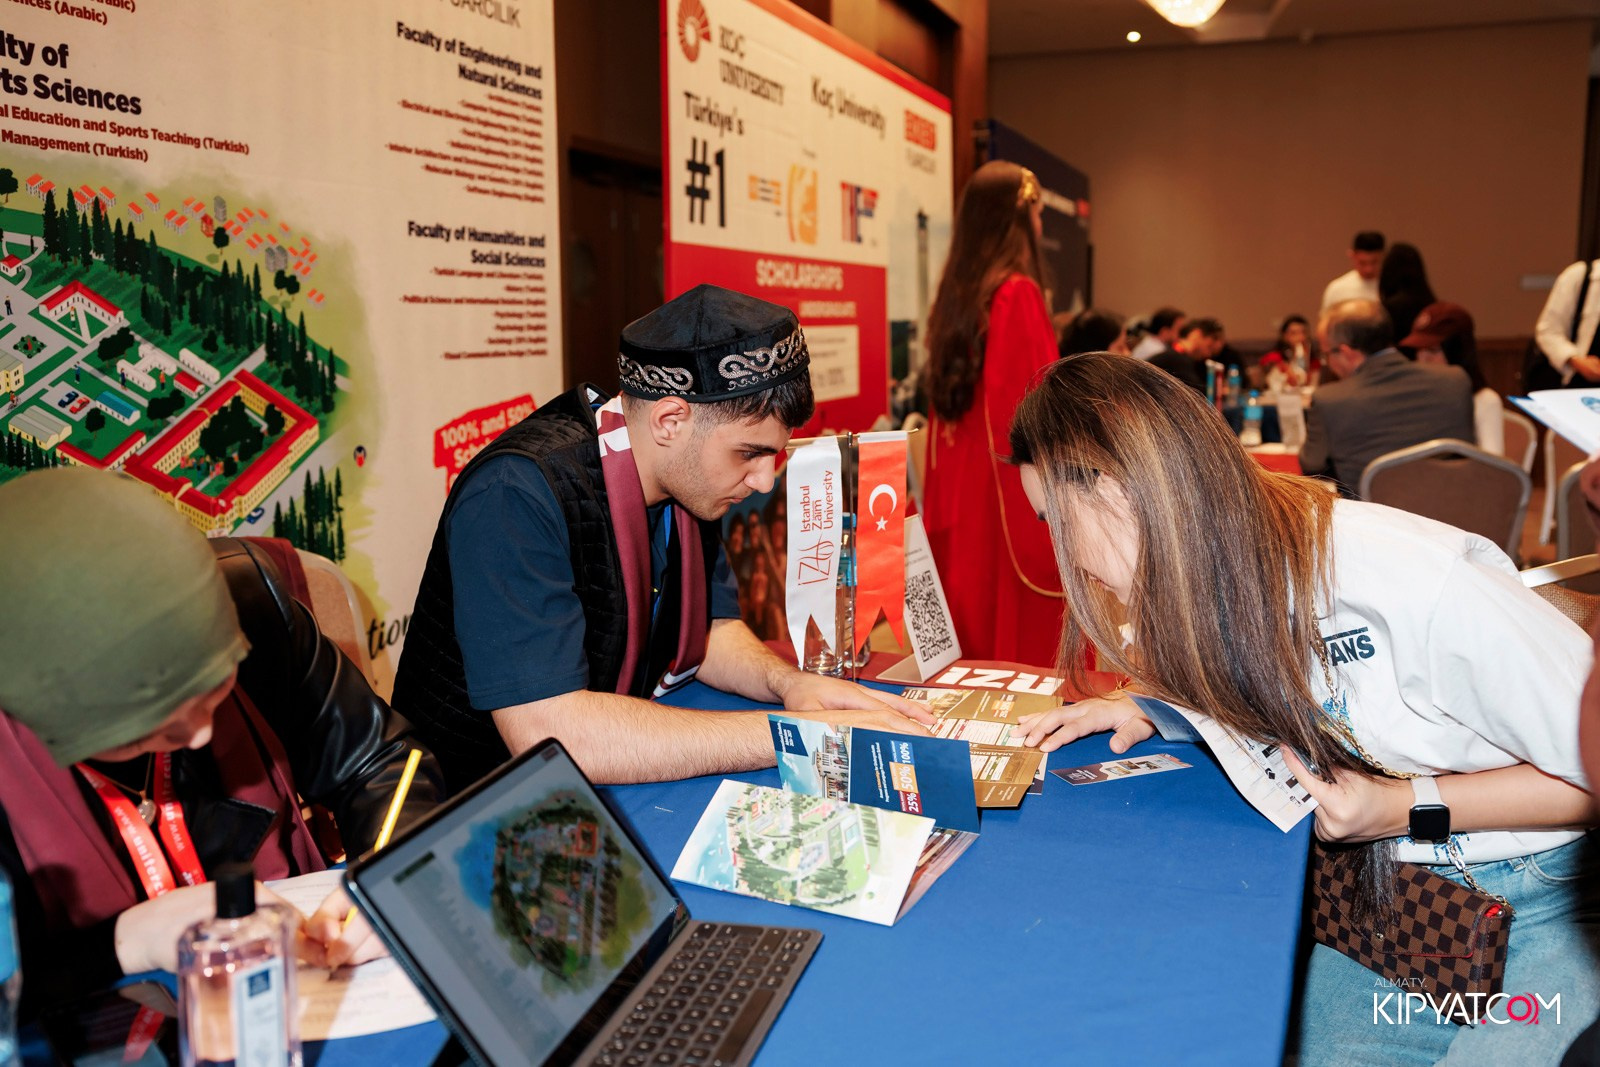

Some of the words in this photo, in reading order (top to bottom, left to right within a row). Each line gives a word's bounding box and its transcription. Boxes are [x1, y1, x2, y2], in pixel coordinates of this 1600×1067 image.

[54, 2, 108, 26] (Arabic)
[42, 43, 69, 69] of
[396, 21, 442, 52] Faculty
[445, 38, 456, 53] of
[459, 41, 522, 76] Engineering
[524, 64, 542, 79] and
[33, 74, 142, 115] Sciences
[458, 64, 498, 88] Natural
[501, 76, 542, 99] Sciences
[1, 129, 90, 154] Management
[93, 142, 149, 163] (Turkish)
[11, 106, 80, 130] Education
[83, 119, 107, 133] and
[109, 122, 149, 139] Sports
[151, 128, 201, 149] Teaching
[203, 137, 250, 155] (Turkish)
[685, 136, 726, 228] #1
[408, 221, 451, 242] Faculty
[454, 226, 465, 240] of
[468, 228, 525, 246] Humanities
[529, 235, 545, 248] and
[471, 249, 502, 265] Social
[505, 252, 545, 268] Sciences
[441, 420, 480, 449] 100%
[481, 415, 506, 435] and
[824, 470, 834, 530] University
[1320, 626, 1376, 666] ANS
[899, 742, 911, 764] 100%
[901, 765, 915, 791] 50%
[907, 792, 920, 813] 25%
